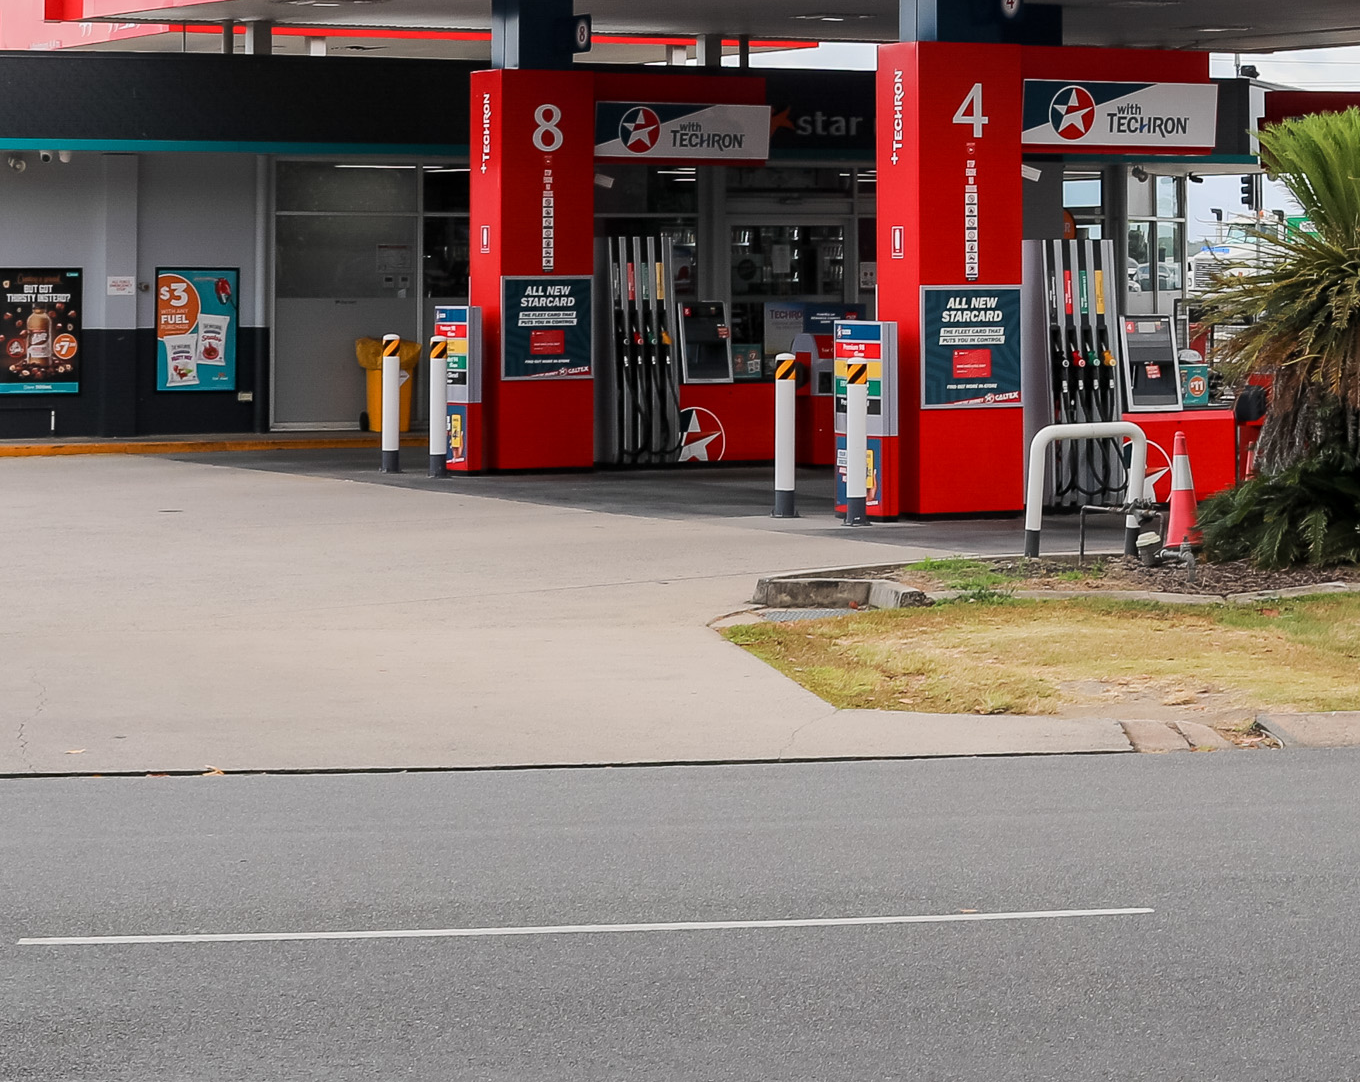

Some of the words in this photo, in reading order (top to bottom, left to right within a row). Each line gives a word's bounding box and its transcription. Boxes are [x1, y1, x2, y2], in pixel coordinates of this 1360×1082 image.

[577, 25, 586, 43] 8
[952, 82, 989, 138] 4
[1116, 103, 1142, 116] with
[532, 103, 564, 152] 8
[679, 121, 702, 133] with
[795, 111, 863, 136] star
[1106, 112, 1188, 138] TECHRON
[670, 129, 745, 151] TECHRON
[23, 284, 38, 293] BUT
[38, 284, 53, 293] GOT
[160, 282, 189, 307] $3
[524, 285, 545, 296] ALL
[546, 285, 571, 296] NEW
[6, 293, 36, 303] THIRSTY
[37, 293, 71, 303] INSTEAD?
[520, 297, 576, 307] STARCARD
[946, 297, 969, 309] ALL
[970, 297, 999, 309] NEW
[160, 314, 189, 325] FUEL
[941, 310, 1003, 322] STARCARD
[1126, 323, 1133, 331] 4
[568, 366, 589, 374] CALTEX
[1190, 380, 1204, 391] $11
[994, 391, 1019, 401] CALTEX
